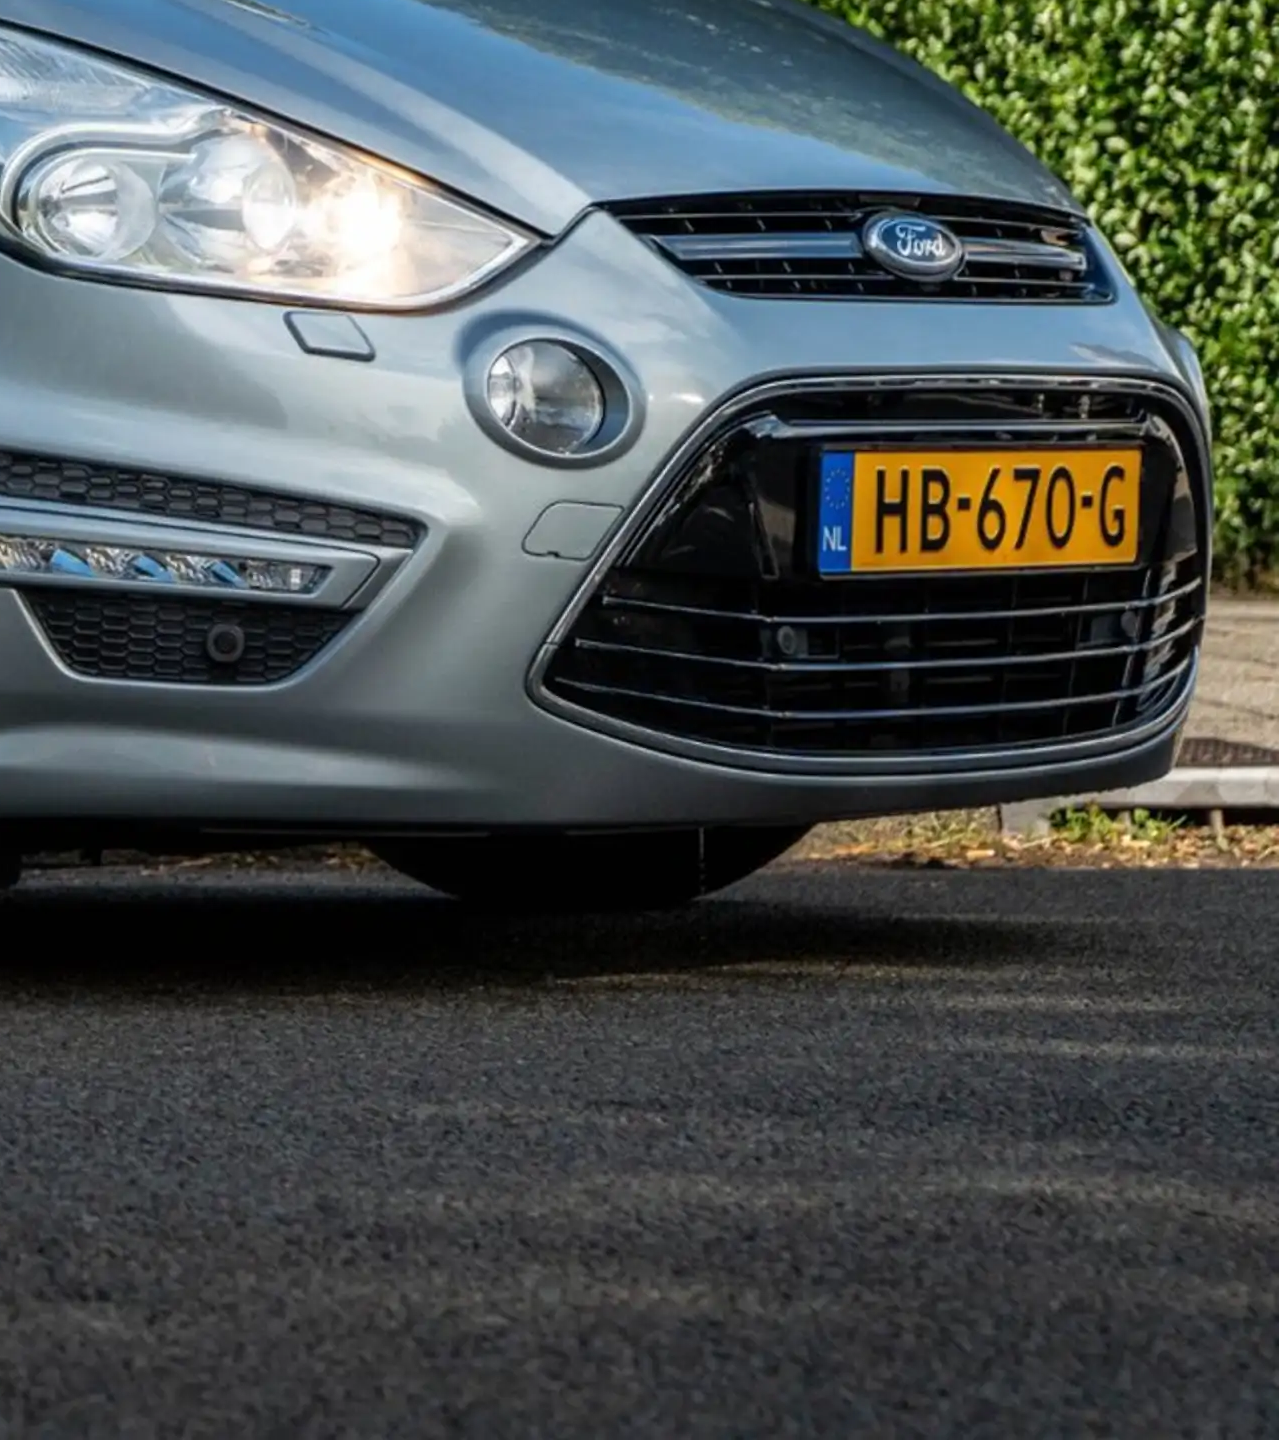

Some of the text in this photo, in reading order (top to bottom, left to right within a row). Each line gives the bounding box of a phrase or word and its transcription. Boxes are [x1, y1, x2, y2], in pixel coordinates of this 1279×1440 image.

[895, 223, 946, 257] Ford
[874, 465, 1126, 554] HB-670-G
[822, 526, 847, 551] NL
